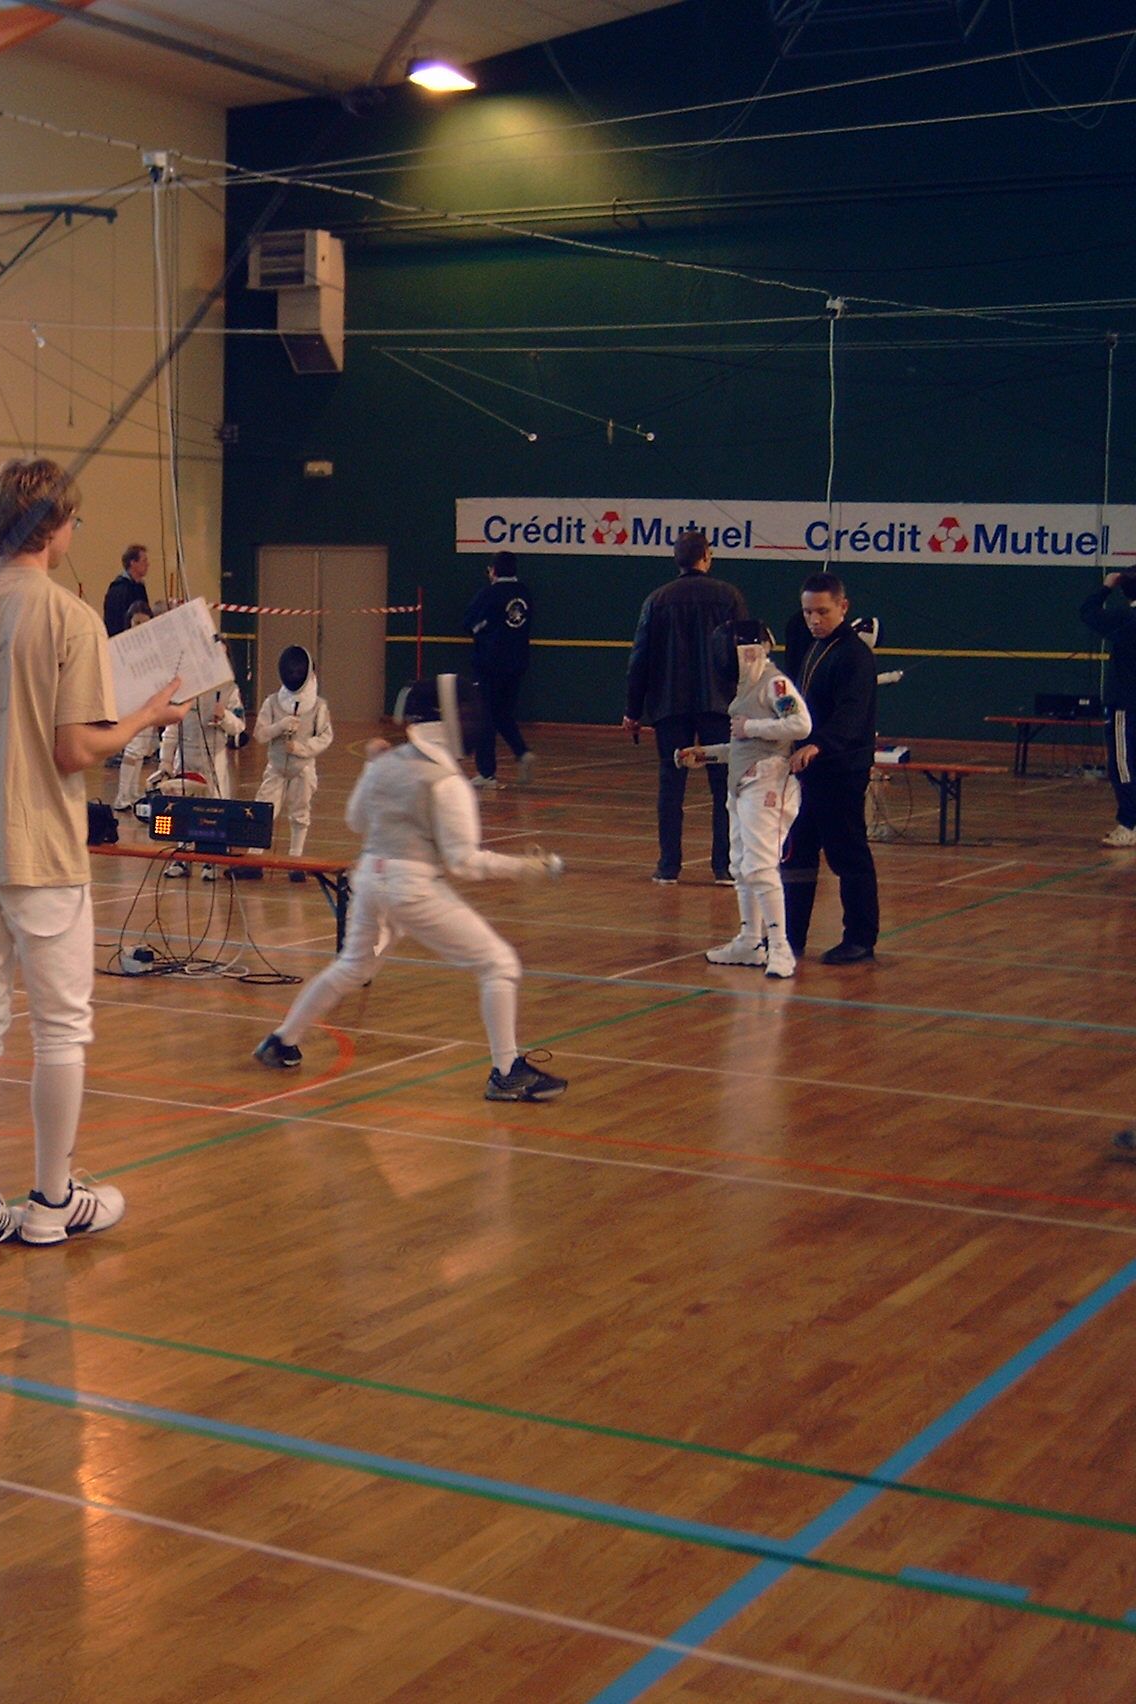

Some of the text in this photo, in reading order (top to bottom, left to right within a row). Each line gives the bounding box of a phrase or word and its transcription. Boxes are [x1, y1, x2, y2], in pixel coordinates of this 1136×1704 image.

[483, 515, 586, 544] Crédit
[805, 521, 921, 552] Crédit
[973, 524, 1110, 555] Mutuel
